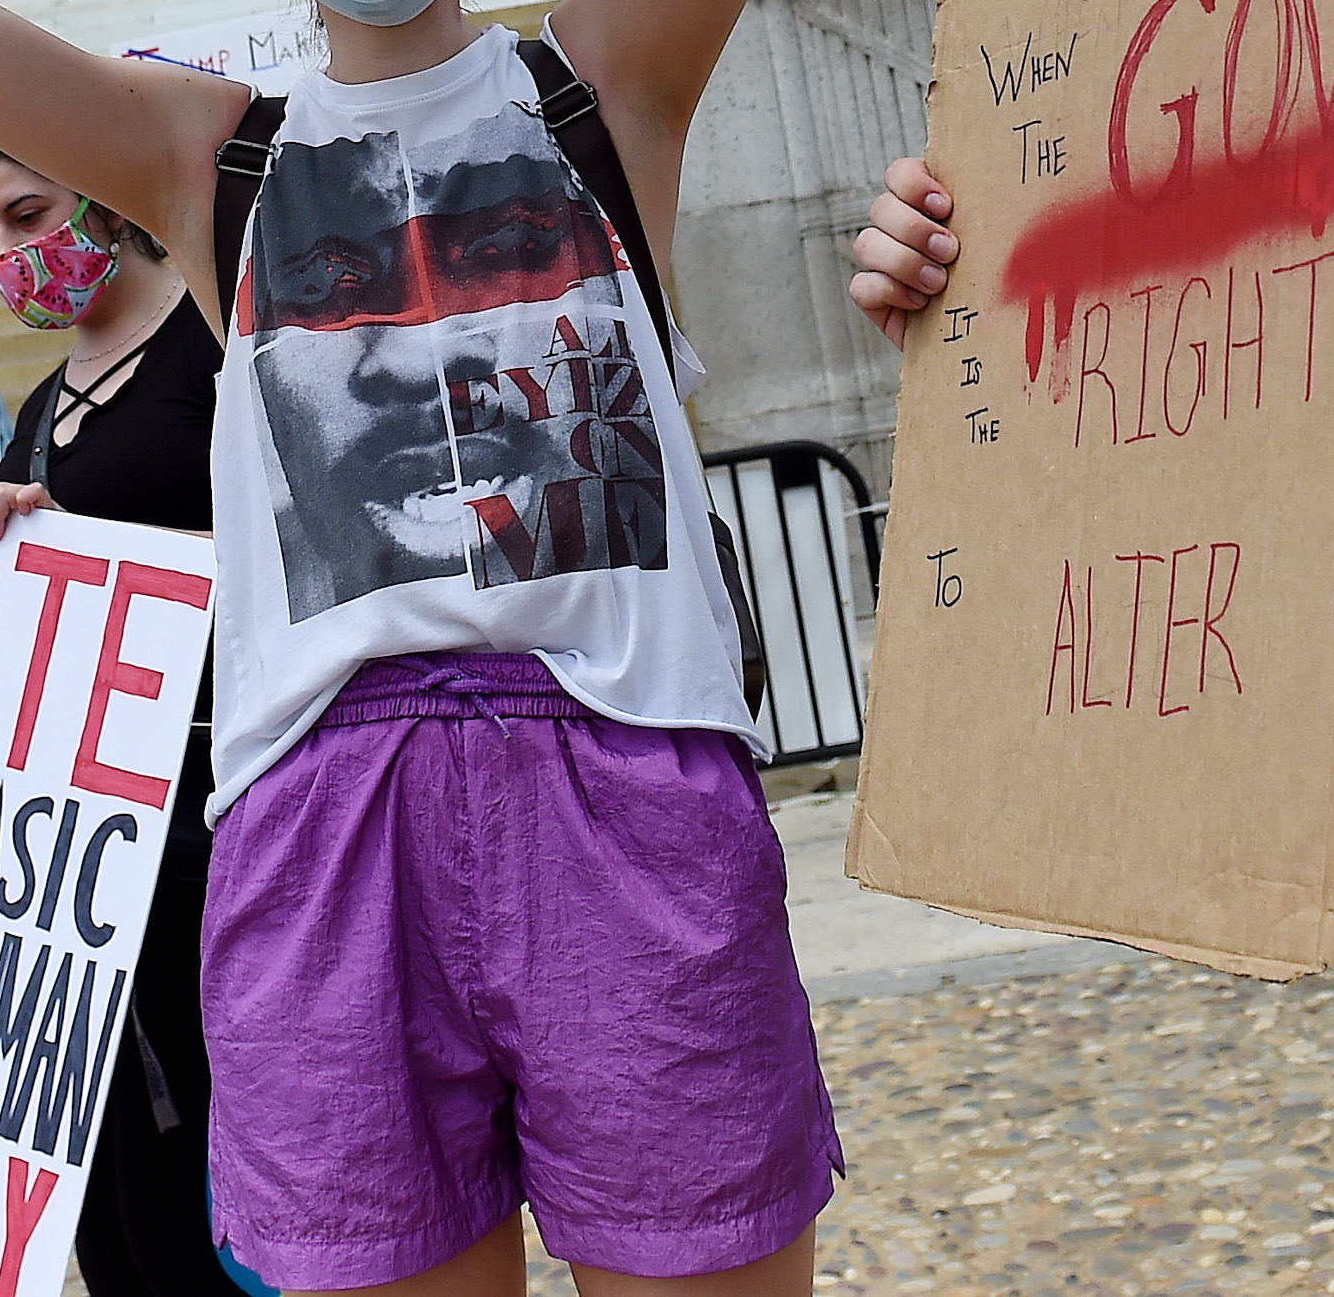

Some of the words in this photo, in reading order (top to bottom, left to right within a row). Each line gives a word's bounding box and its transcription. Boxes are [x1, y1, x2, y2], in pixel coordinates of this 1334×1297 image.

[979, 32, 1078, 105] WHEN
[1013, 120, 1068, 184] THE
[965, 408, 1001, 445] THE
[1047, 539, 1242, 717] ALTER
